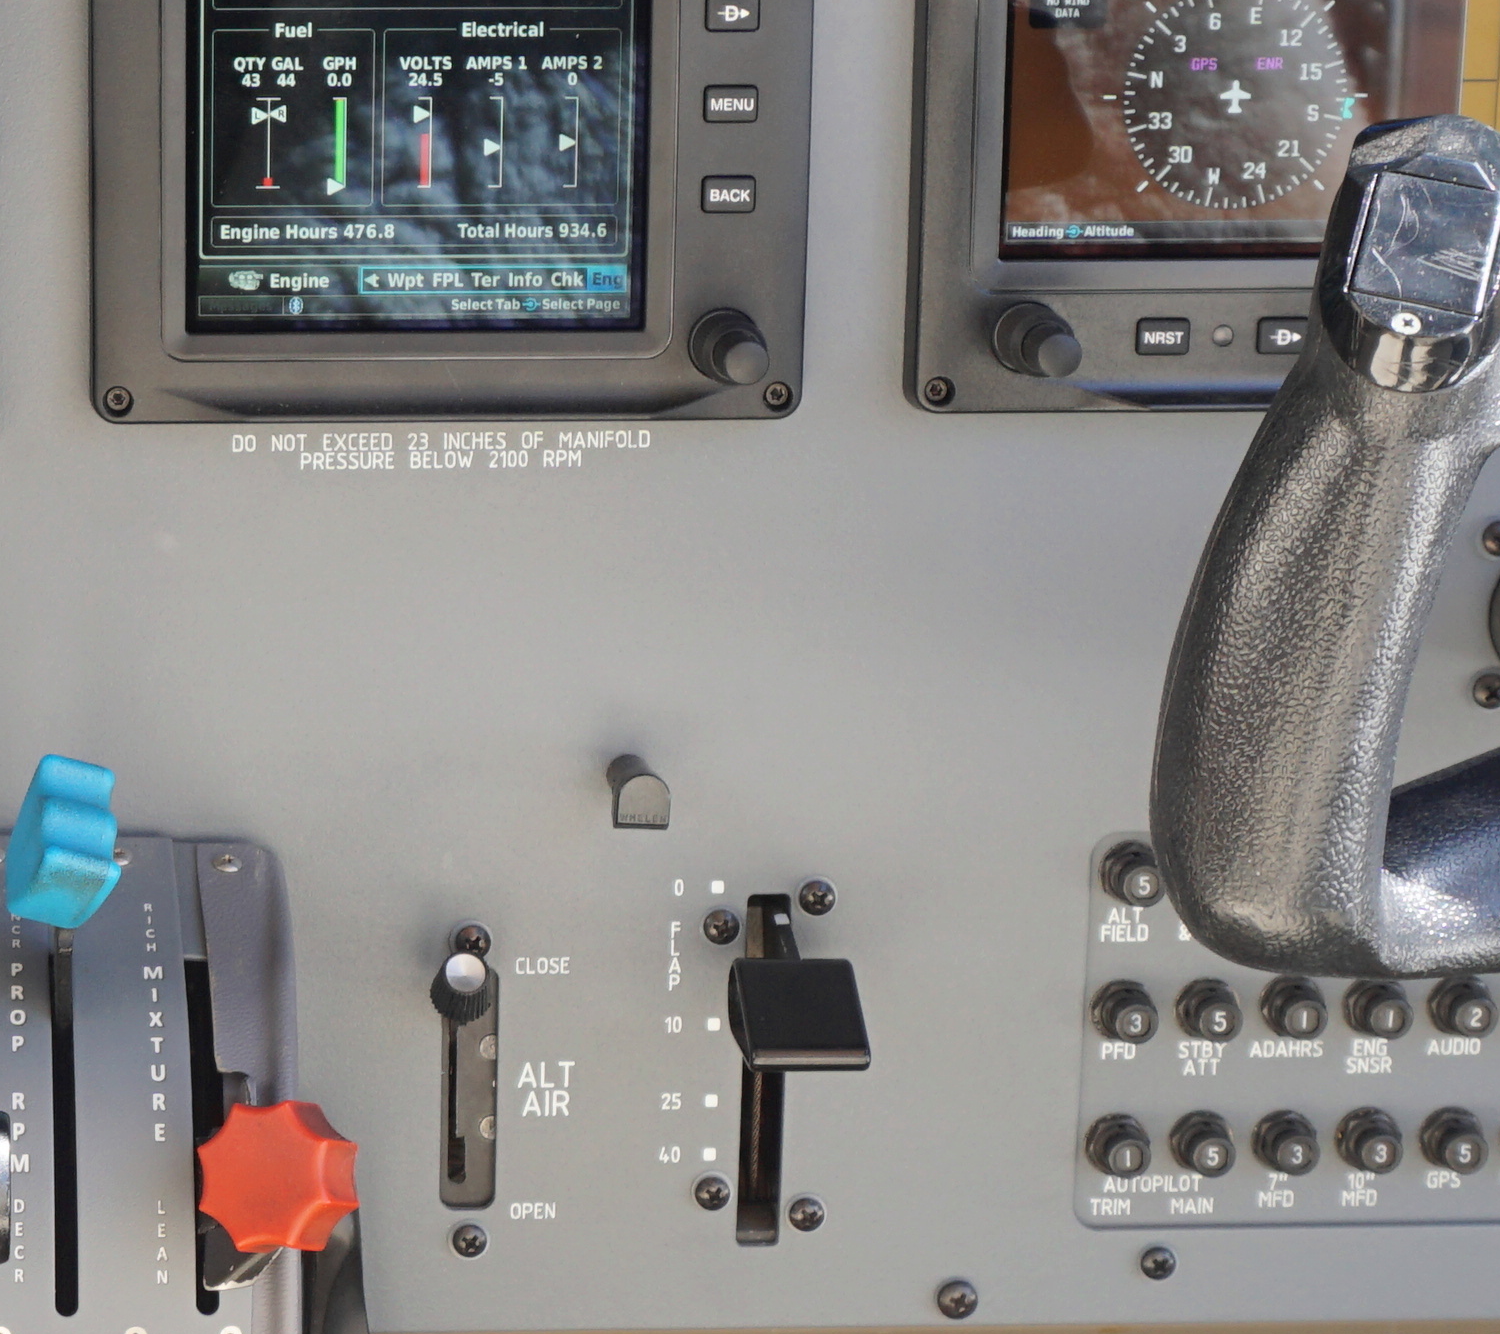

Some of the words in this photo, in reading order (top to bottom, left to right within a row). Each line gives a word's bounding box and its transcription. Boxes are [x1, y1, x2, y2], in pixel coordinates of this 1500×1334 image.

[461, 22, 543, 38] Electrical
[710, 97, 754, 113] MENU
[710, 188, 750, 203] BACK
[220, 224, 285, 242] Engine
[290, 224, 338, 239] Hours
[343, 224, 395, 239] 476.8
[458, 223, 498, 239] Total
[504, 223, 553, 239] Hours
[559, 222, 607, 238] 934.6
[232, 435, 257, 452] DO
[272, 435, 309, 452] NOT
[323, 433, 393, 452] EXCEED
[408, 433, 429, 450] 23
[443, 432, 508, 450] INCHES
[521, 432, 543, 449] OF
[559, 431, 651, 449] MANIFOLD
[300, 453, 395, 470] PRESSURE
[409, 452, 475, 469] BELOW
[490, 451, 527, 468] 2100
[542, 450, 582, 468] RPM
[1109, 908, 1143, 924] ALT
[1100, 925, 1149, 942] FIELD
[515, 958, 570, 974] CLOSE
[11, 964, 26, 1051] PROP
[144, 967, 166, 1142] MIXTURE
[1102, 1043, 1136, 1059] PFD
[1179, 1042, 1226, 1059] STBY
[1250, 1042, 1323, 1058] ADAHRS
[1428, 1039, 1481, 1056] AUDIO
[518, 1062, 575, 1088] ALT
[1184, 1059, 1219, 1075] ATT
[522, 1091, 569, 1117] AIR
[11, 1093, 30, 1173] RPM
[1104, 1176, 1202, 1193] AUTOPILOT
[510, 1203, 556, 1220] OPEN
[1091, 1199, 1131, 1215] TRIM
[1171, 1198, 1213, 1215] MAIN
